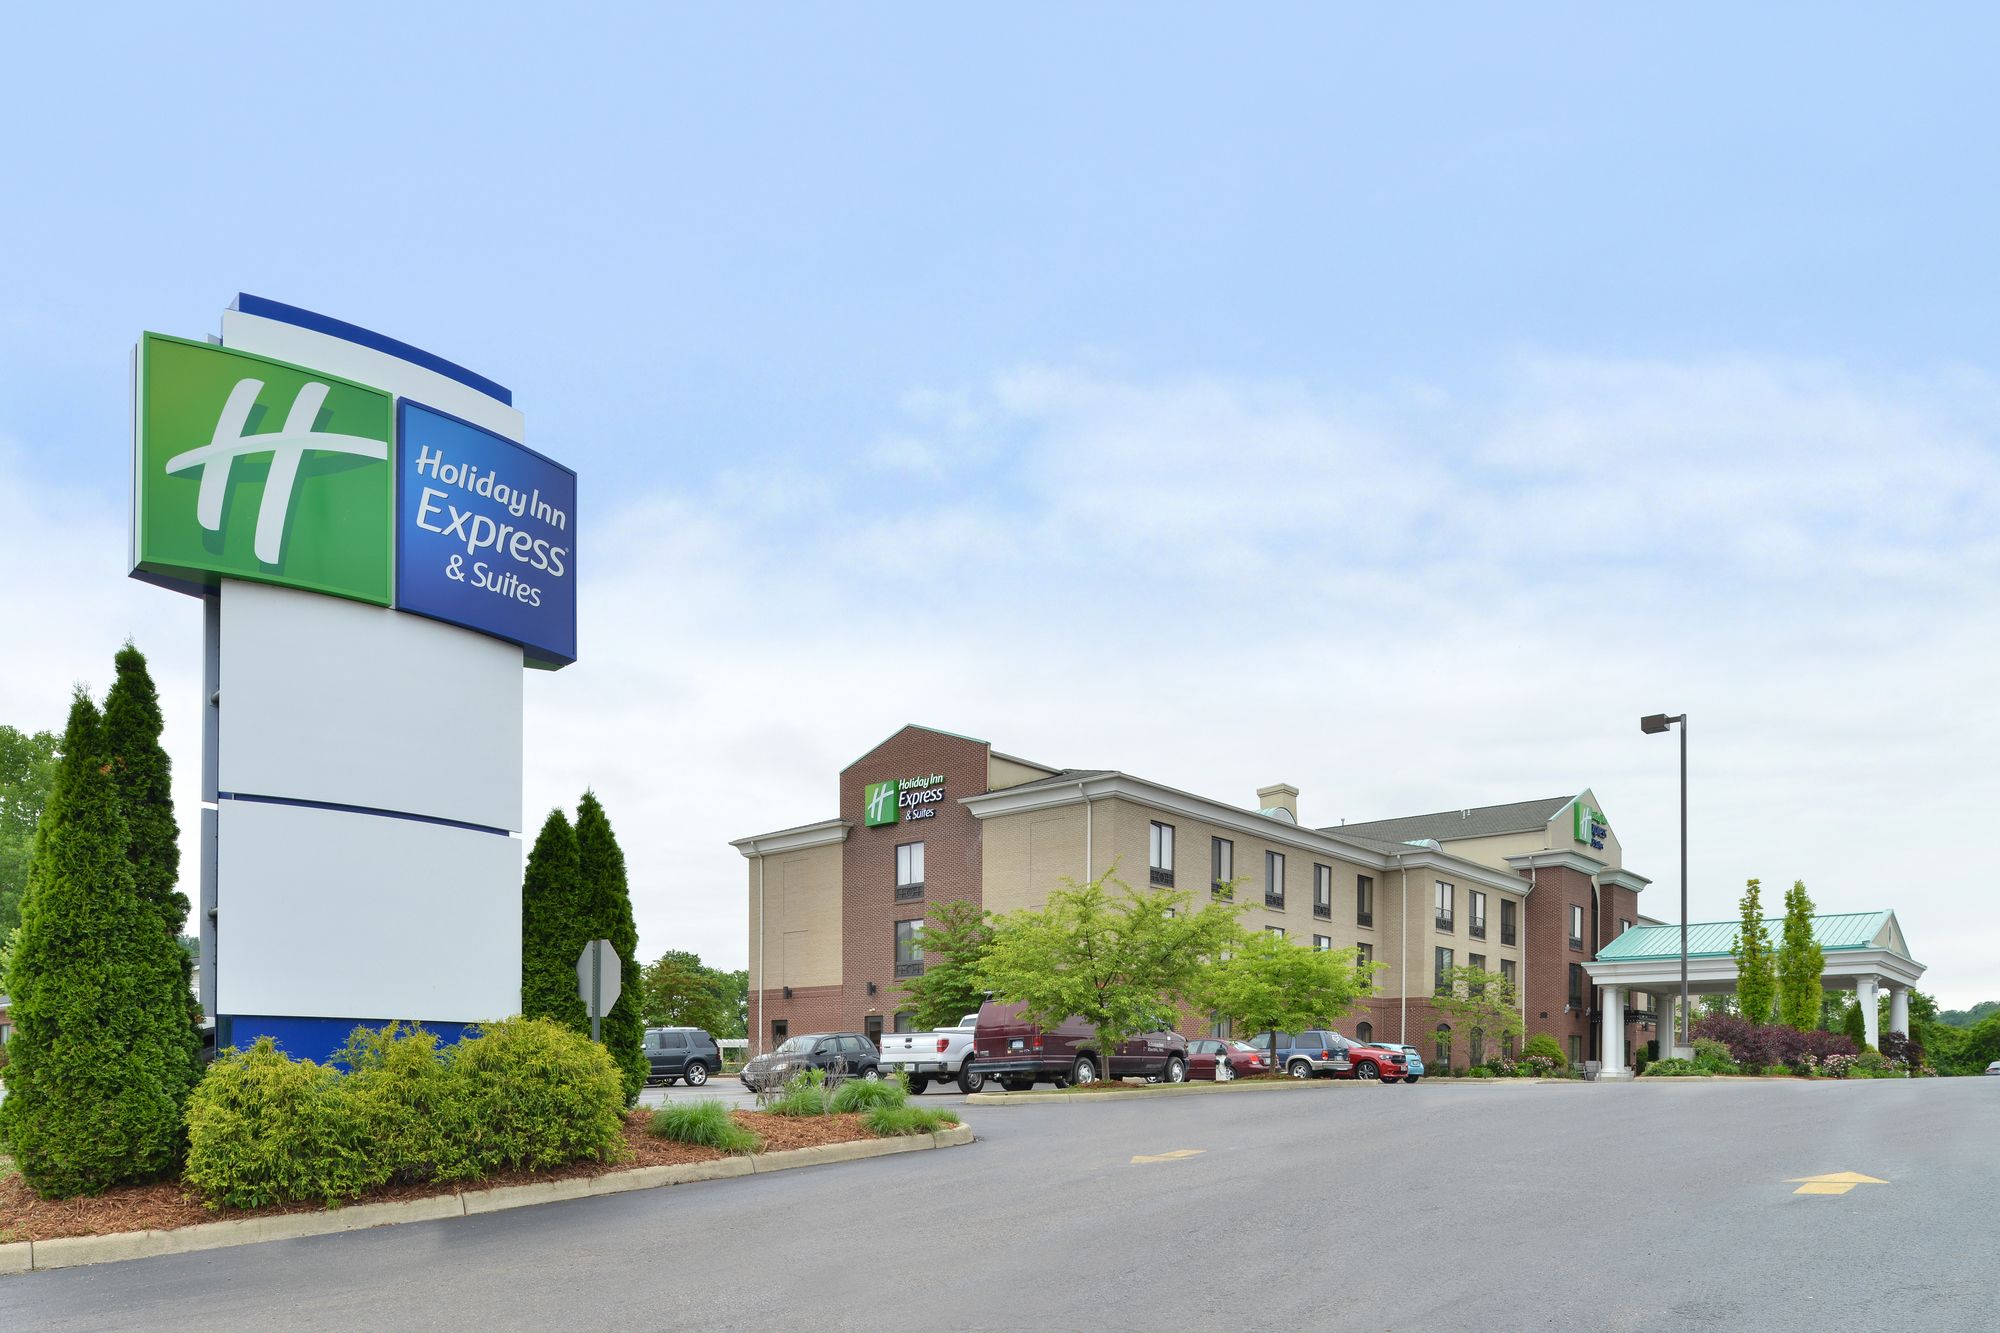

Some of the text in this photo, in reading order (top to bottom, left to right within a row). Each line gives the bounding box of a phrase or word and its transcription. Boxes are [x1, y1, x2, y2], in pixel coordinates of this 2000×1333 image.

[416, 445, 566, 531] Holiday Inn
[416, 487, 567, 577] Express
[445, 554, 541, 607] & Suites
[898, 773, 944, 790] Holiday Inn
[898, 788, 943, 809] Express
[905, 808, 934, 820] & Suites
